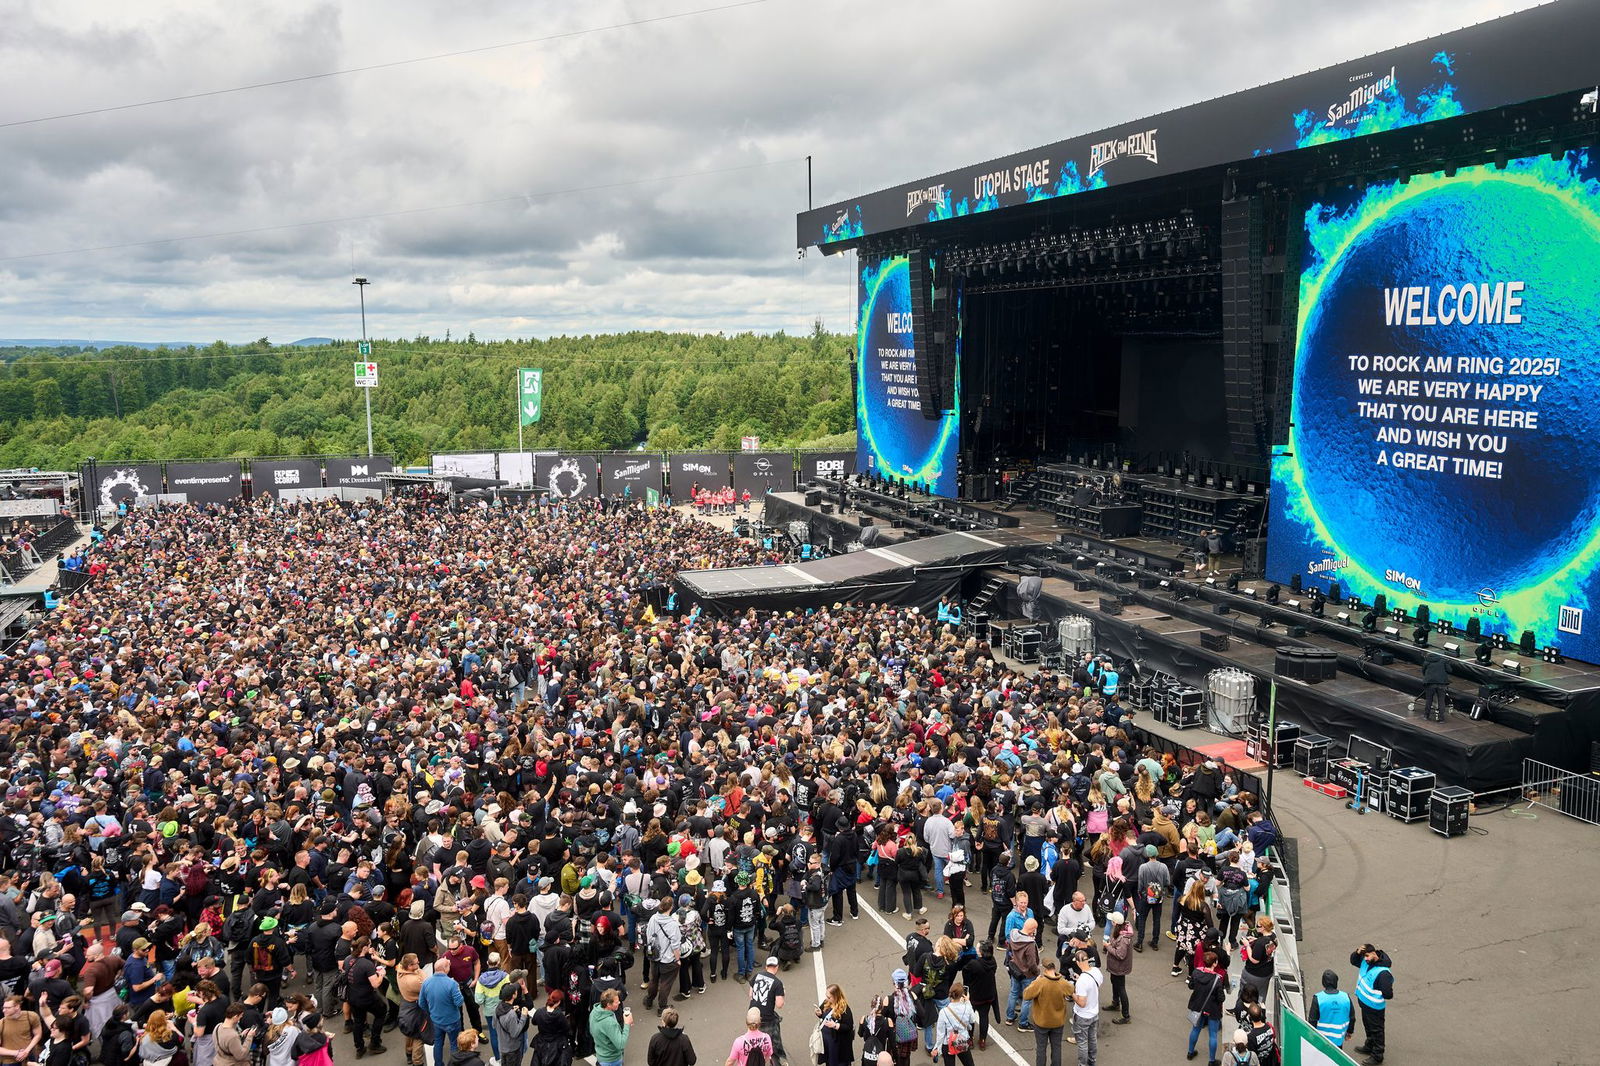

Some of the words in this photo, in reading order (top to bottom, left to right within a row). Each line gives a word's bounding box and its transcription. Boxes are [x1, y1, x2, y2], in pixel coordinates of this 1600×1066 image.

[1089, 139, 1118, 177] ROCK
[1127, 128, 1158, 164] RING
[974, 169, 1011, 200] UTOPIA
[1013, 159, 1050, 191] STAGE
[907, 189, 923, 217] ROCK
[1384, 281, 1525, 326] WELCOME
[887, 312, 913, 333] WELCO
[878, 348, 885, 357] TO
[885, 348, 898, 357] ROCK
[900, 348, 908, 357] AM
[907, 349, 915, 358] RI
[881, 361, 889, 370] WE
[889, 361, 899, 370] ARE
[899, 361, 912, 371] VERY
[1348, 355, 1369, 371] TO
[1372, 356, 1421, 372] ROCK
[1424, 356, 1452, 373] AM
[1457, 357, 1504, 374] RING
[1508, 358, 1561, 375] 2025!
[881, 373, 893, 382] THAT
[893, 374, 904, 383] YOU
[904, 375, 914, 384] ARE
[887, 386, 898, 395] AND
[898, 387, 911, 396] WISH
[1358, 379, 1382, 395] WE
[1385, 380, 1419, 396] ARE
[1423, 381, 1471, 398] VERY
[1475, 384, 1543, 402] HAPPY
[887, 398, 892, 407] A
[891, 399, 907, 409] GREAT
[1357, 402, 1397, 419] THAT
[1400, 404, 1437, 423] YOU
[1441, 407, 1479, 425] ARE
[1484, 409, 1539, 429] HERE
[1376, 427, 1412, 444] AND
[1416, 429, 1461, 449] WISH
[1466, 433, 1507, 454] YOU
[682, 463, 711, 473] SIMON
[816, 460, 844, 471] BOB!
[1376, 450, 1389, 466] A
[1392, 451, 1448, 472] GREAT
[1452, 457, 1503, 479] TIME!
[274, 476, 300, 484] SCORPIO
[1385, 569, 1420, 590] SIMON
[1473, 607, 1499, 617] OPEL
[892, 665, 903, 674] 25
